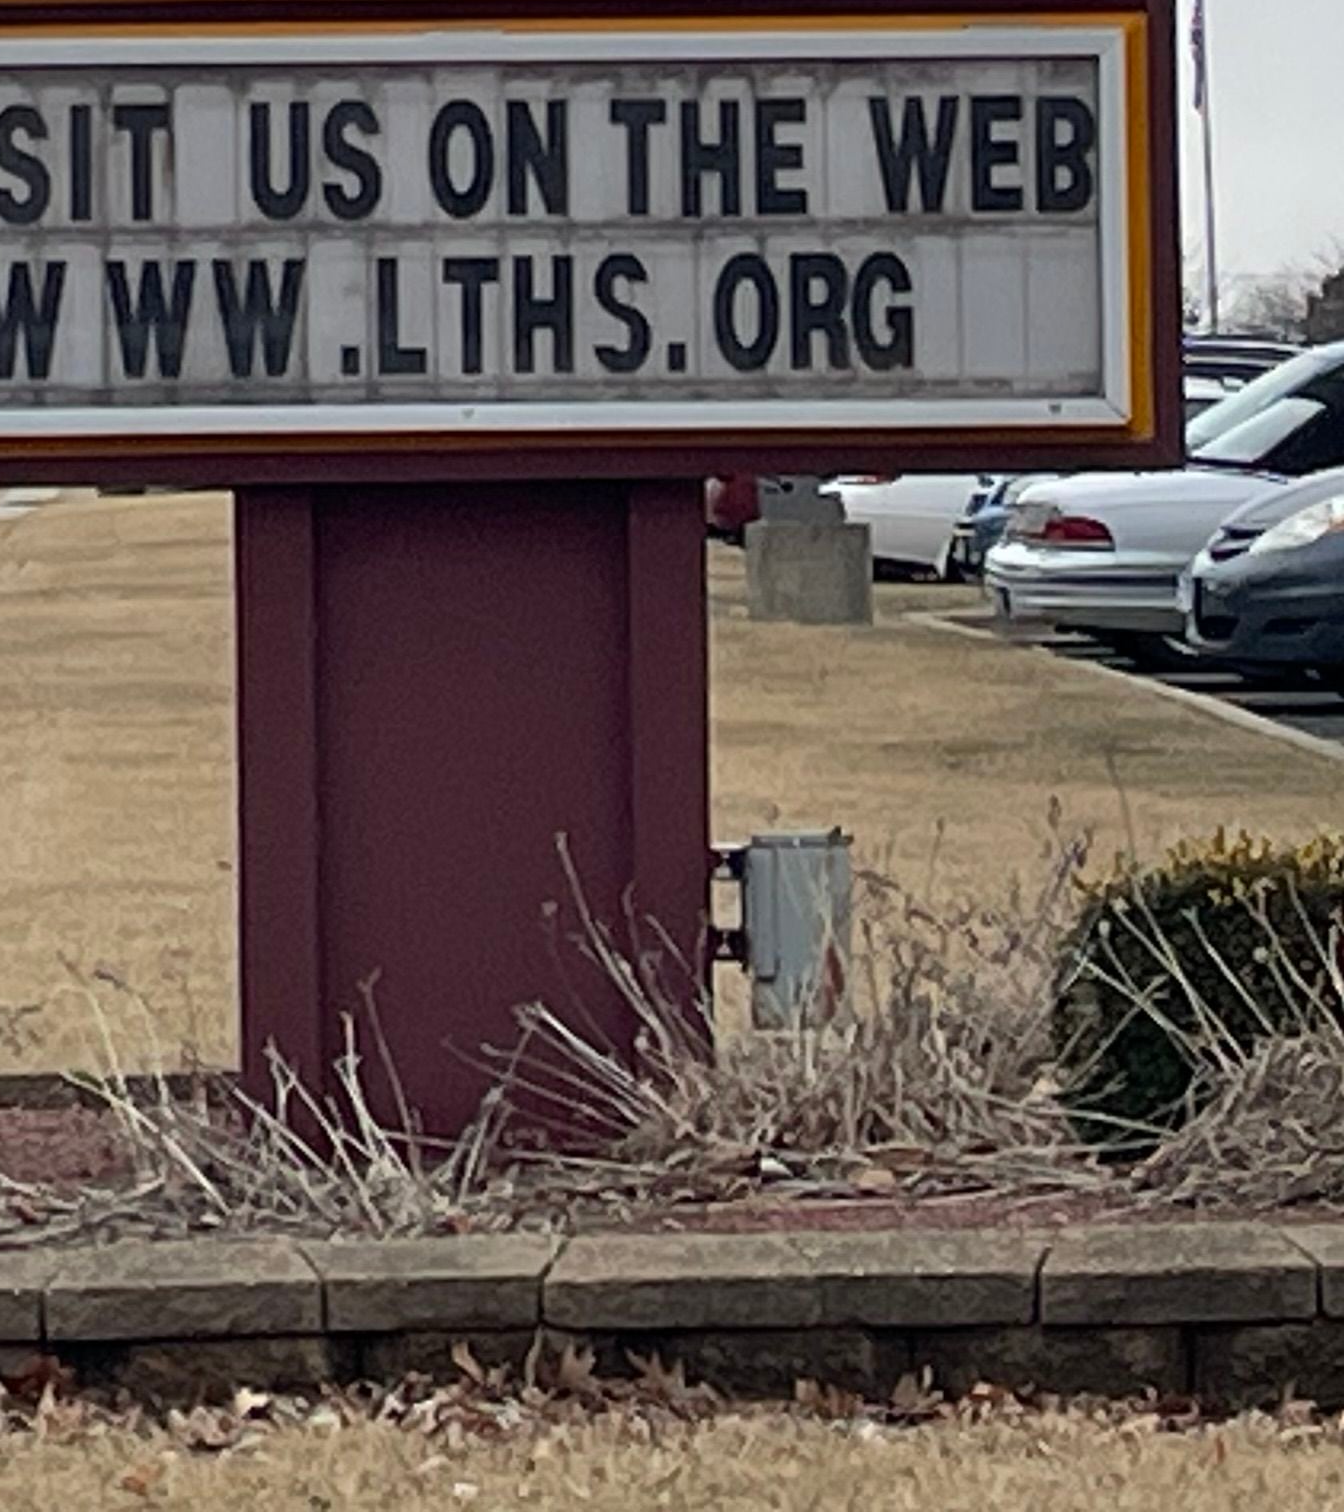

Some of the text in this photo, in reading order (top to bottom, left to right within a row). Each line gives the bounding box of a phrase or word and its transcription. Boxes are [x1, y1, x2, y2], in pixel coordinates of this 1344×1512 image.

[249, 99, 382, 220] US
[428, 99, 568, 217] ON
[610, 98, 808, 214] THE
[869, 93, 1093, 212] WEB
